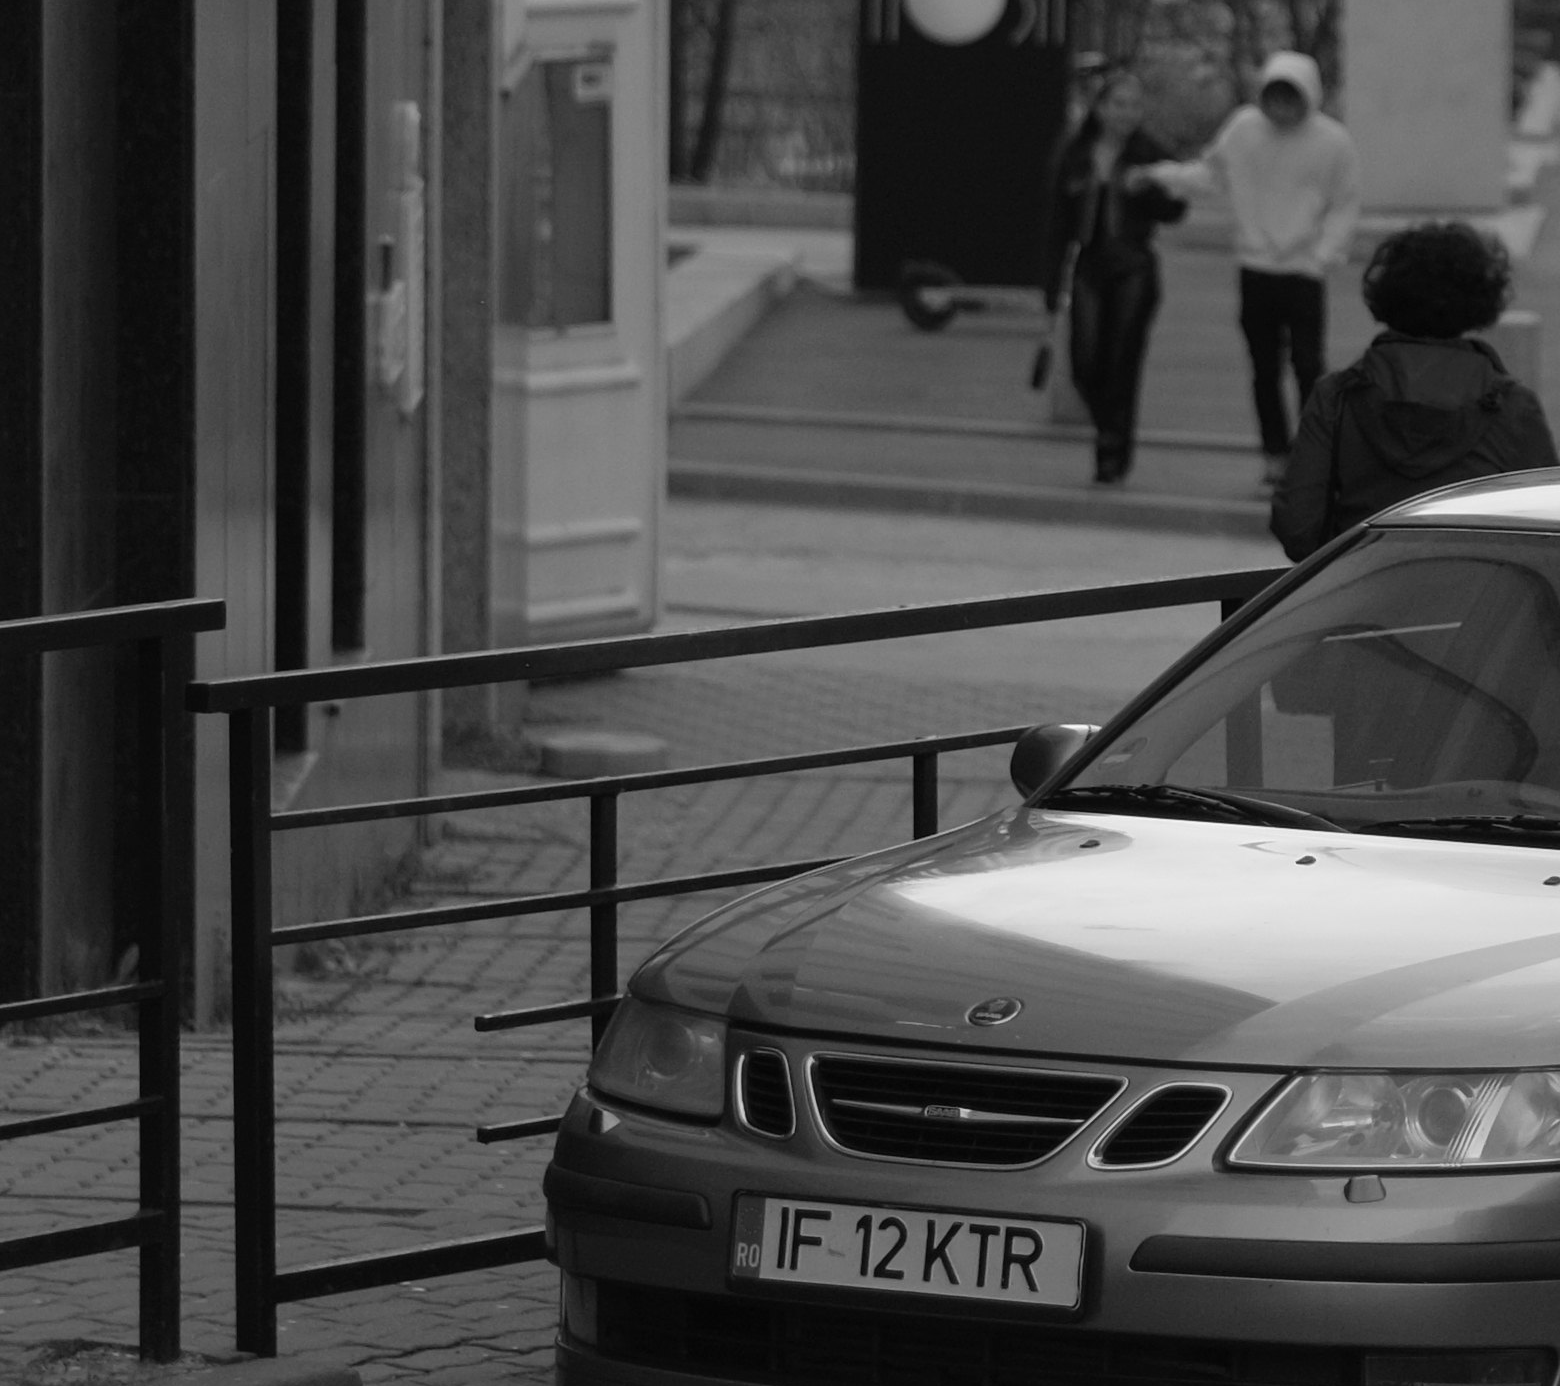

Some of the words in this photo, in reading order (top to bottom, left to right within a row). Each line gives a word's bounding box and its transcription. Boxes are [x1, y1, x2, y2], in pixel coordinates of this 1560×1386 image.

[736, 1242, 761, 1268] RO
[776, 1207, 832, 1271] IF
[855, 1214, 908, 1281] 12
[922, 1219, 1044, 1293] KTR
